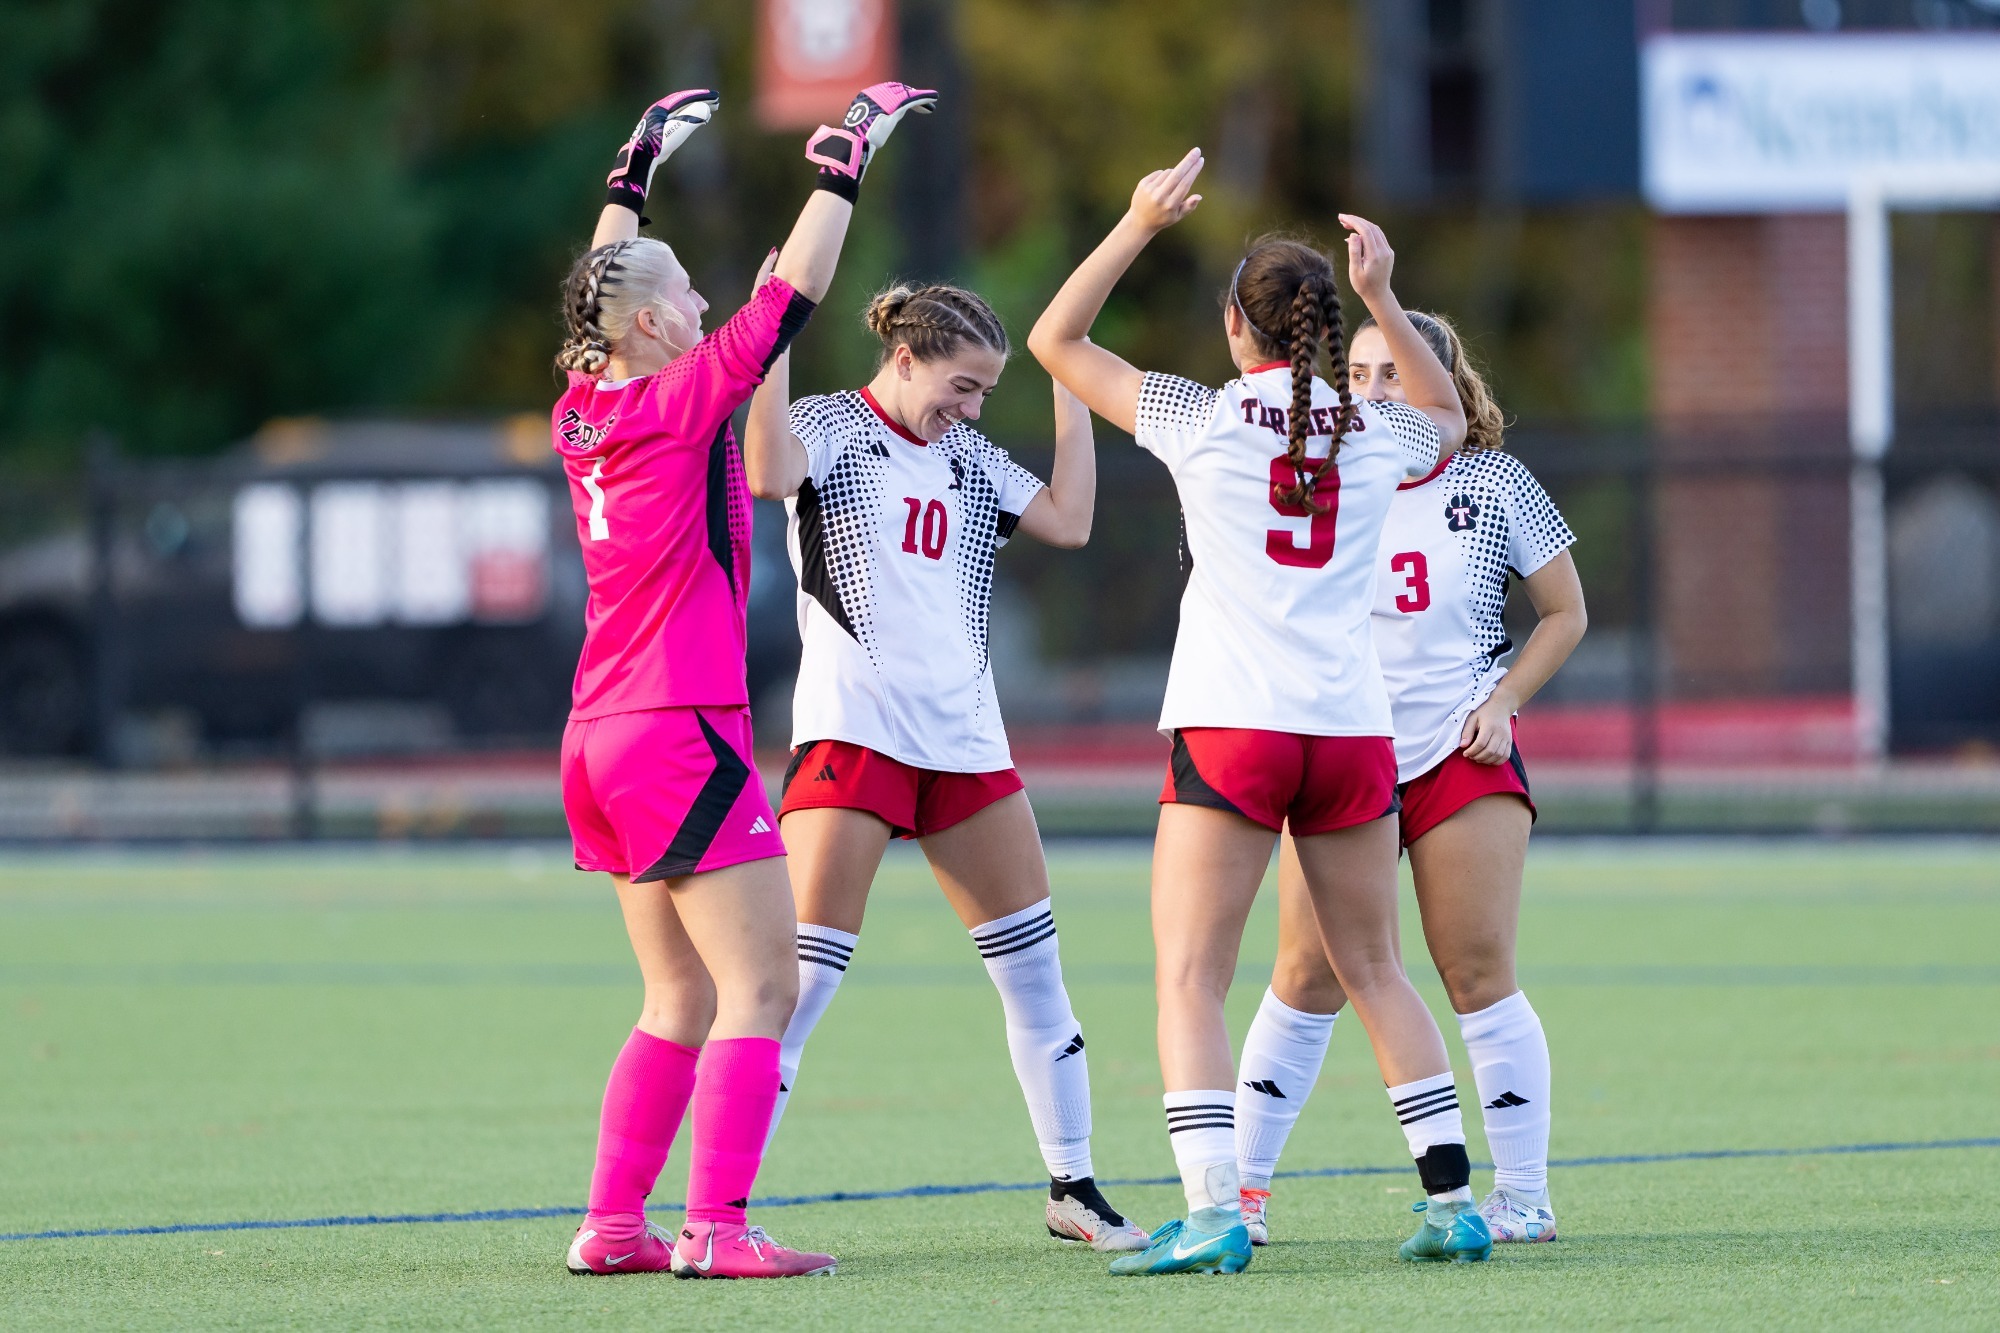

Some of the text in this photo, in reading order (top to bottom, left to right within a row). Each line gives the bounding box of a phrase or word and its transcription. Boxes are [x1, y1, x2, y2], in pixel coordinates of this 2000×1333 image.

[1240, 398, 1367, 437] TRES
[581, 456, 610, 541] 1
[901, 496, 948, 561] 10
[1265, 453, 1342, 569] 9
[1390, 551, 1431, 613] 3
